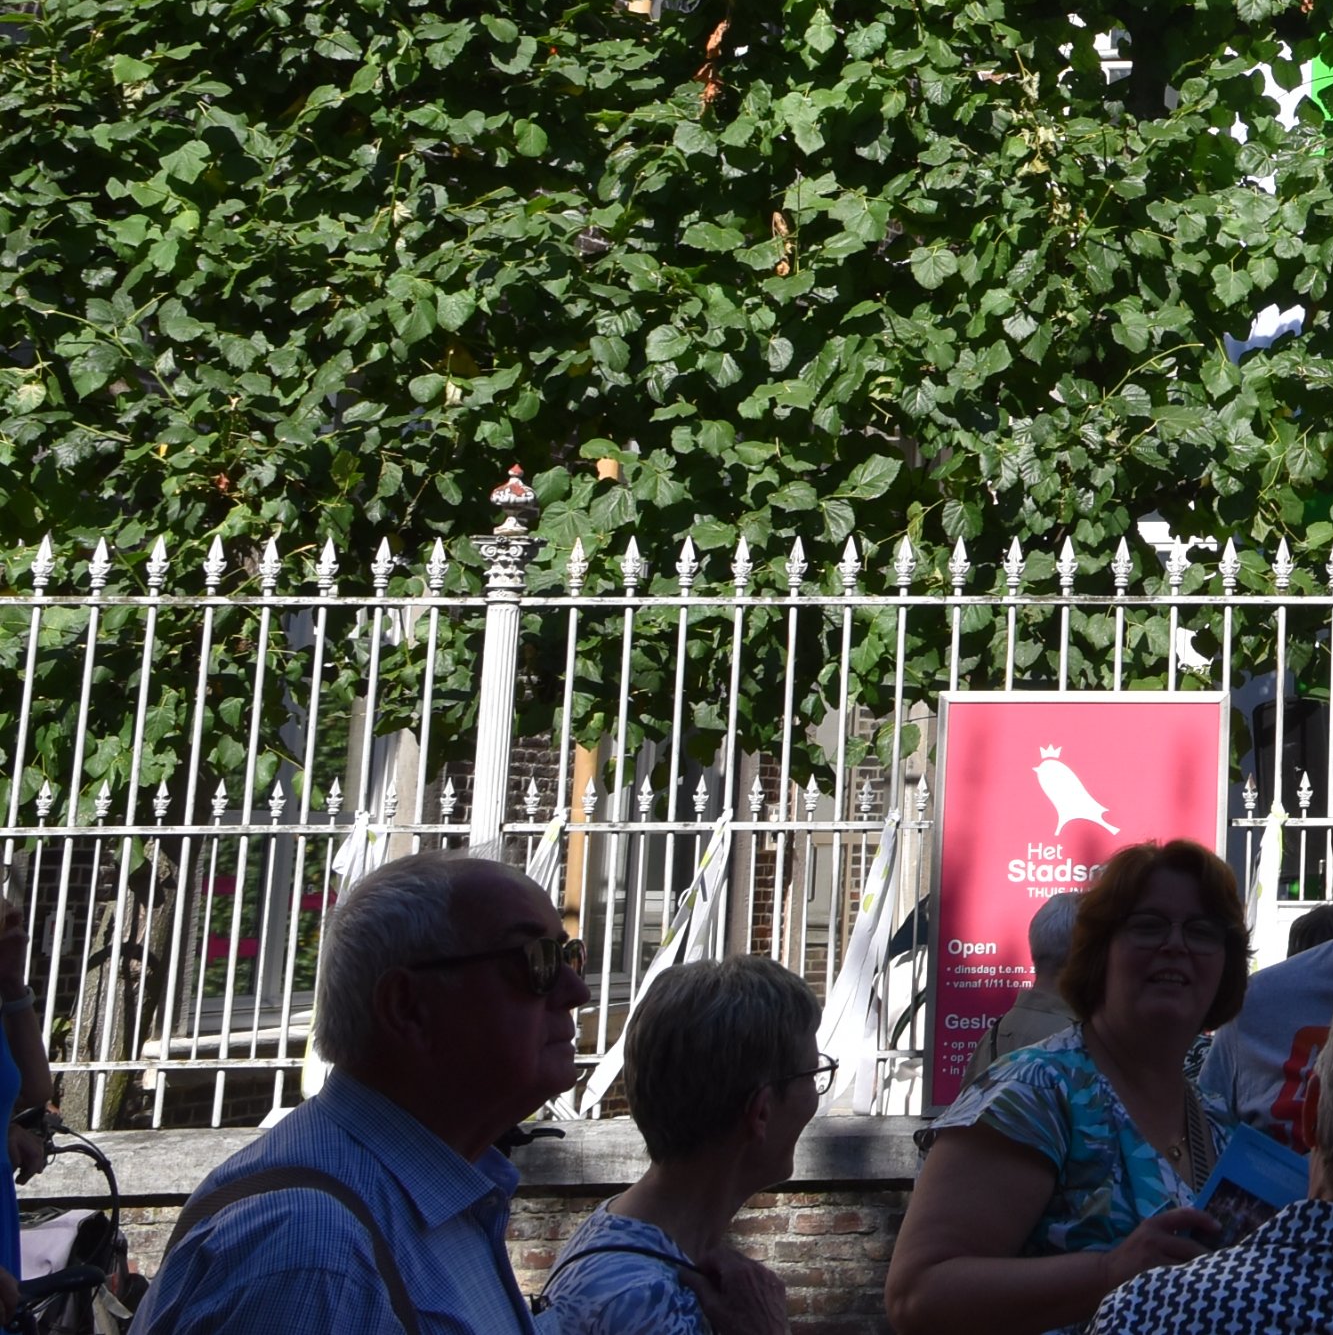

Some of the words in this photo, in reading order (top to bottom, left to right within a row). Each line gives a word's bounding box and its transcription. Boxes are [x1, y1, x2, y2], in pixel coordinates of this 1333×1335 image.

[1027, 842, 1063, 860] Het
[947, 939, 997, 959] Open
[954, 965, 996, 976] dinsdag
[999, 965, 1028, 974] t.e.m.
[953, 979, 982, 988] vanaf
[984, 979, 1004, 988] 1/11
[945, 1013, 1003, 1029] Geslo
[951, 1041, 965, 1050] op
[950, 1055, 964, 1064] op
